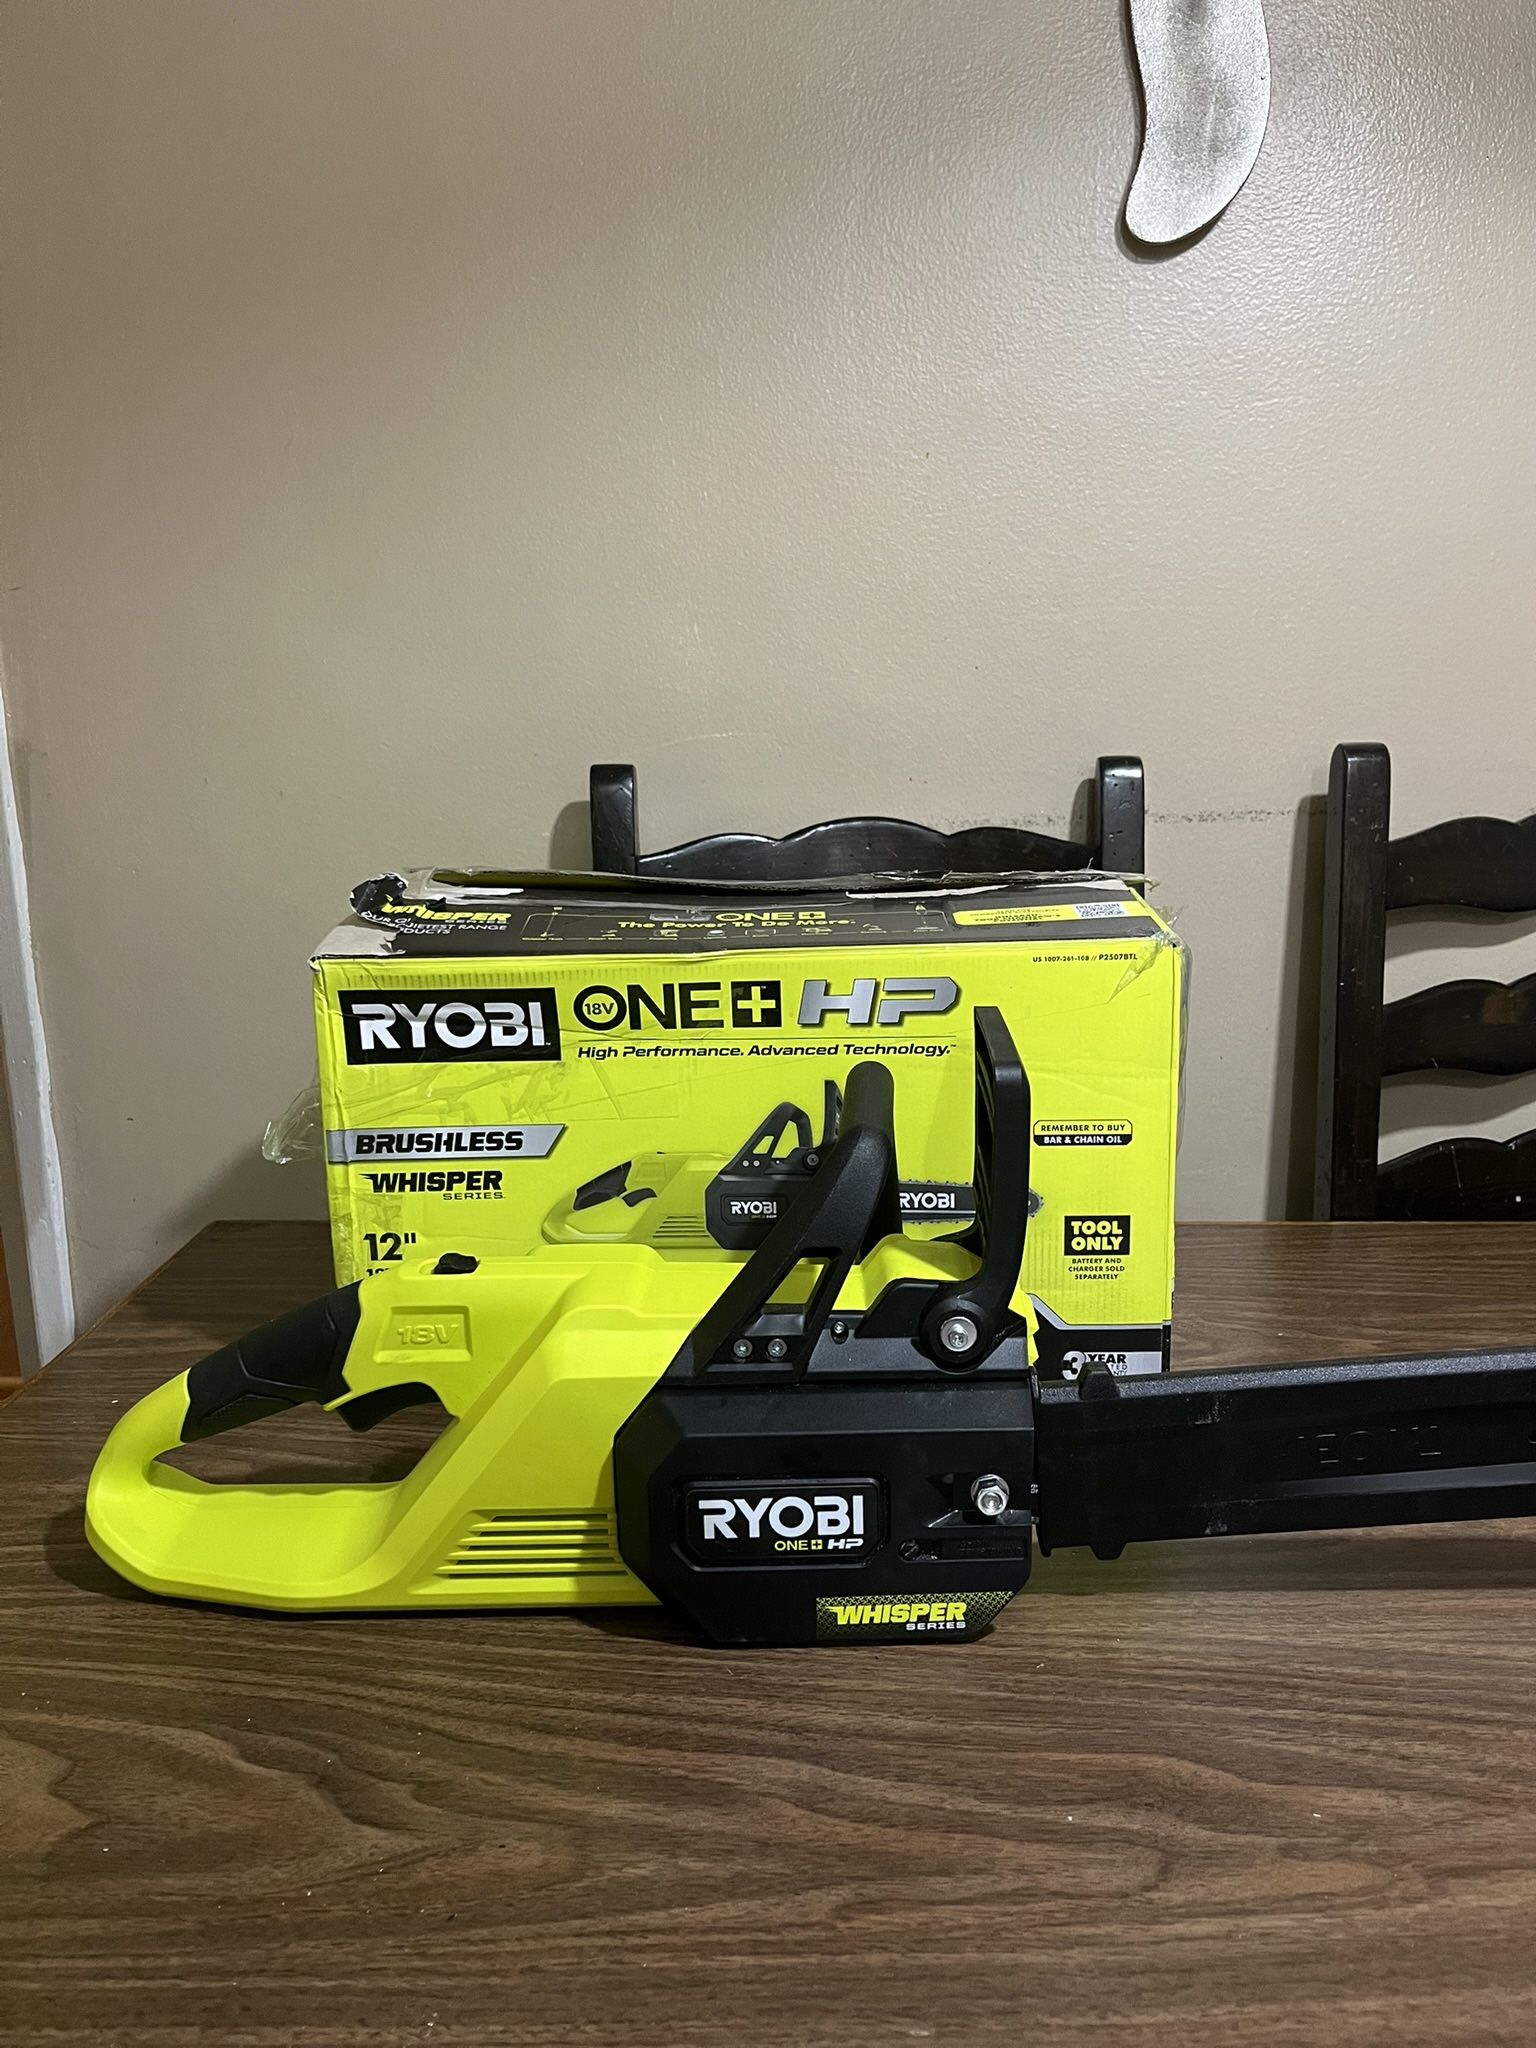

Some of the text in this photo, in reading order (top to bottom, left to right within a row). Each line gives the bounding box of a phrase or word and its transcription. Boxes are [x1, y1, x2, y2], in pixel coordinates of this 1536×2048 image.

[458, 924, 508, 932] RANGE
[618, 921, 655, 929] The
[662, 920, 726, 929] Power
[733, 920, 755, 928] To
[761, 920, 790, 928] Do
[585, 1002, 614, 1016] 18V
[797, 976, 961, 1028] HP
[351, 1001, 545, 1050] RYOBI
[577, 1046, 618, 1060] High
[622, 1045, 744, 1058] Performance.
[748, 1043, 839, 1057] Advanced
[1041, 1124, 1089, 1132] REMEMBER
[355, 1131, 524, 1154] BRUSHLESS
[1044, 1136, 1062, 1144] BAR
[1064, 1136, 1071, 1144] &
[1106, 1135, 1122, 1143] OIL
[359, 1170, 503, 1193] WHISPER
[443, 1192, 504, 1200] SERIES
[900, 1192, 955, 1209] RYOBI
[730, 1201, 777, 1214] RYOBI
[1071, 1220, 1123, 1235] TOOL
[363, 1232, 416, 1261] 12"
[1071, 1236, 1124, 1250] ONLY
[397, 1324, 460, 1344] 18V
[1062, 1350, 1127, 1380] 3 YEAR
[698, 1495, 864, 1539] RYOBI
[827, 1538, 864, 1550] HP
[825, 1602, 967, 1625] WHISPER
[906, 1621, 966, 1631] SERIES
